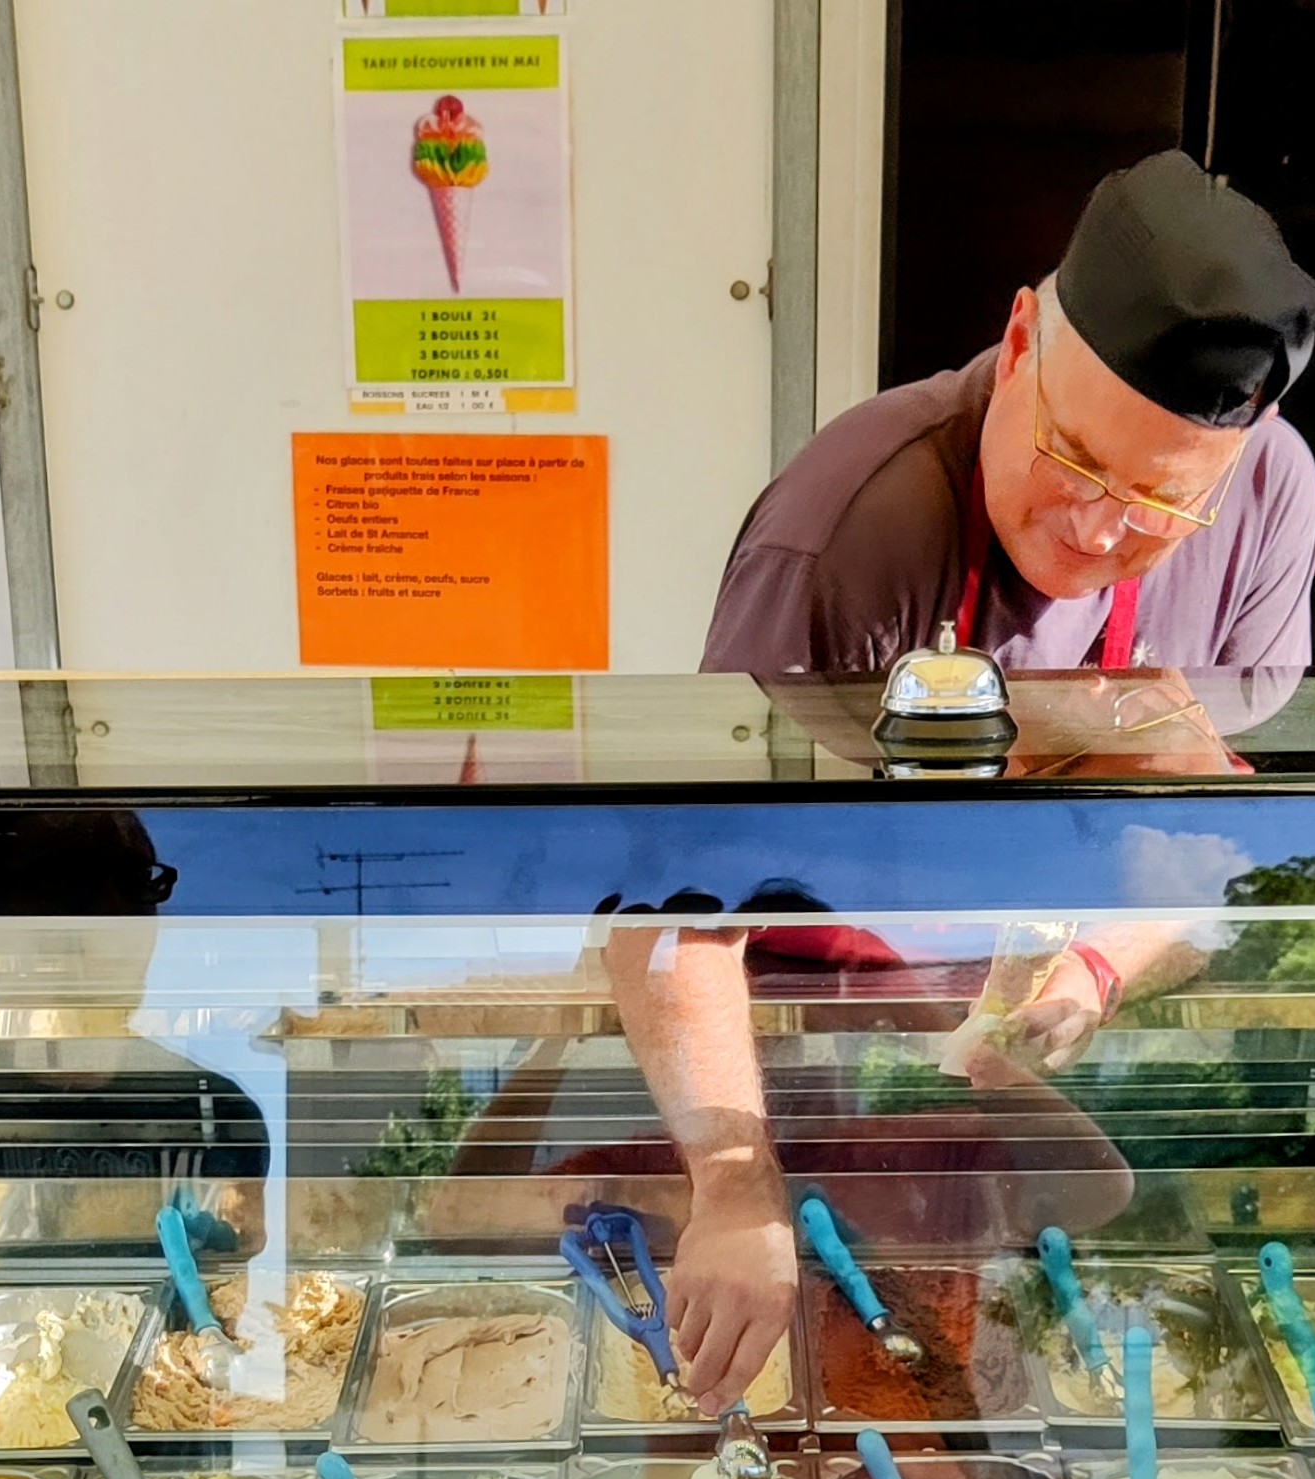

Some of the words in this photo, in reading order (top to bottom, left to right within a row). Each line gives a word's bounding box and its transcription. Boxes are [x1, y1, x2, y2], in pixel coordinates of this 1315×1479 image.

[362, 57, 398, 70] TARIF
[403, 54, 486, 69] DÉCOUVERTE
[491, 56, 508, 68] EN
[514, 55, 540, 68] MAI
[432, 311, 473, 322] BOULE
[419, 331, 427, 342] 2
[431, 331, 479, 342] BOULES
[419, 350, 427, 361] 3
[431, 350, 479, 361] BOULES
[411, 369, 460, 381] TOPING
[315, 455, 338, 466] Nos
[340, 455, 376, 470] glaces
[379, 456, 403, 466] sont
[405, 456, 440, 467] toutes
[443, 456, 473, 468] faites
[476, 459, 493, 468] sur
[496, 457, 526, 471] place
[529, 456, 536, 468] à
[538, 457, 568, 472] partir
[570, 458, 584, 468] de
[364, 471, 409, 484] produits
[411, 471, 435, 481] frais
[438, 472, 467, 482] selon
[470, 472, 486, 482] les
[489, 472, 530, 483] saisons
[326, 485, 365, 495] Fraises
[426, 486, 440, 496] de
[442, 486, 480, 497] France
[326, 499, 359, 510] Citron
[362, 500, 380, 510] bio
[327, 514, 359, 525] Oeufs
[361, 515, 399, 525] entiers
[327, 529, 347, 539] Lait
[350, 529, 364, 539] de
[367, 529, 378, 539] St
[381, 529, 429, 540] Amancet
[328, 543, 364, 554] Crème
[316, 572, 354, 583] Glaces
[460, 576, 490, 585] sucre
[317, 586, 359, 597] Sorbets
[367, 587, 395, 598] fruits
[398, 588, 409, 598] et
[411, 589, 441, 598] sucre
